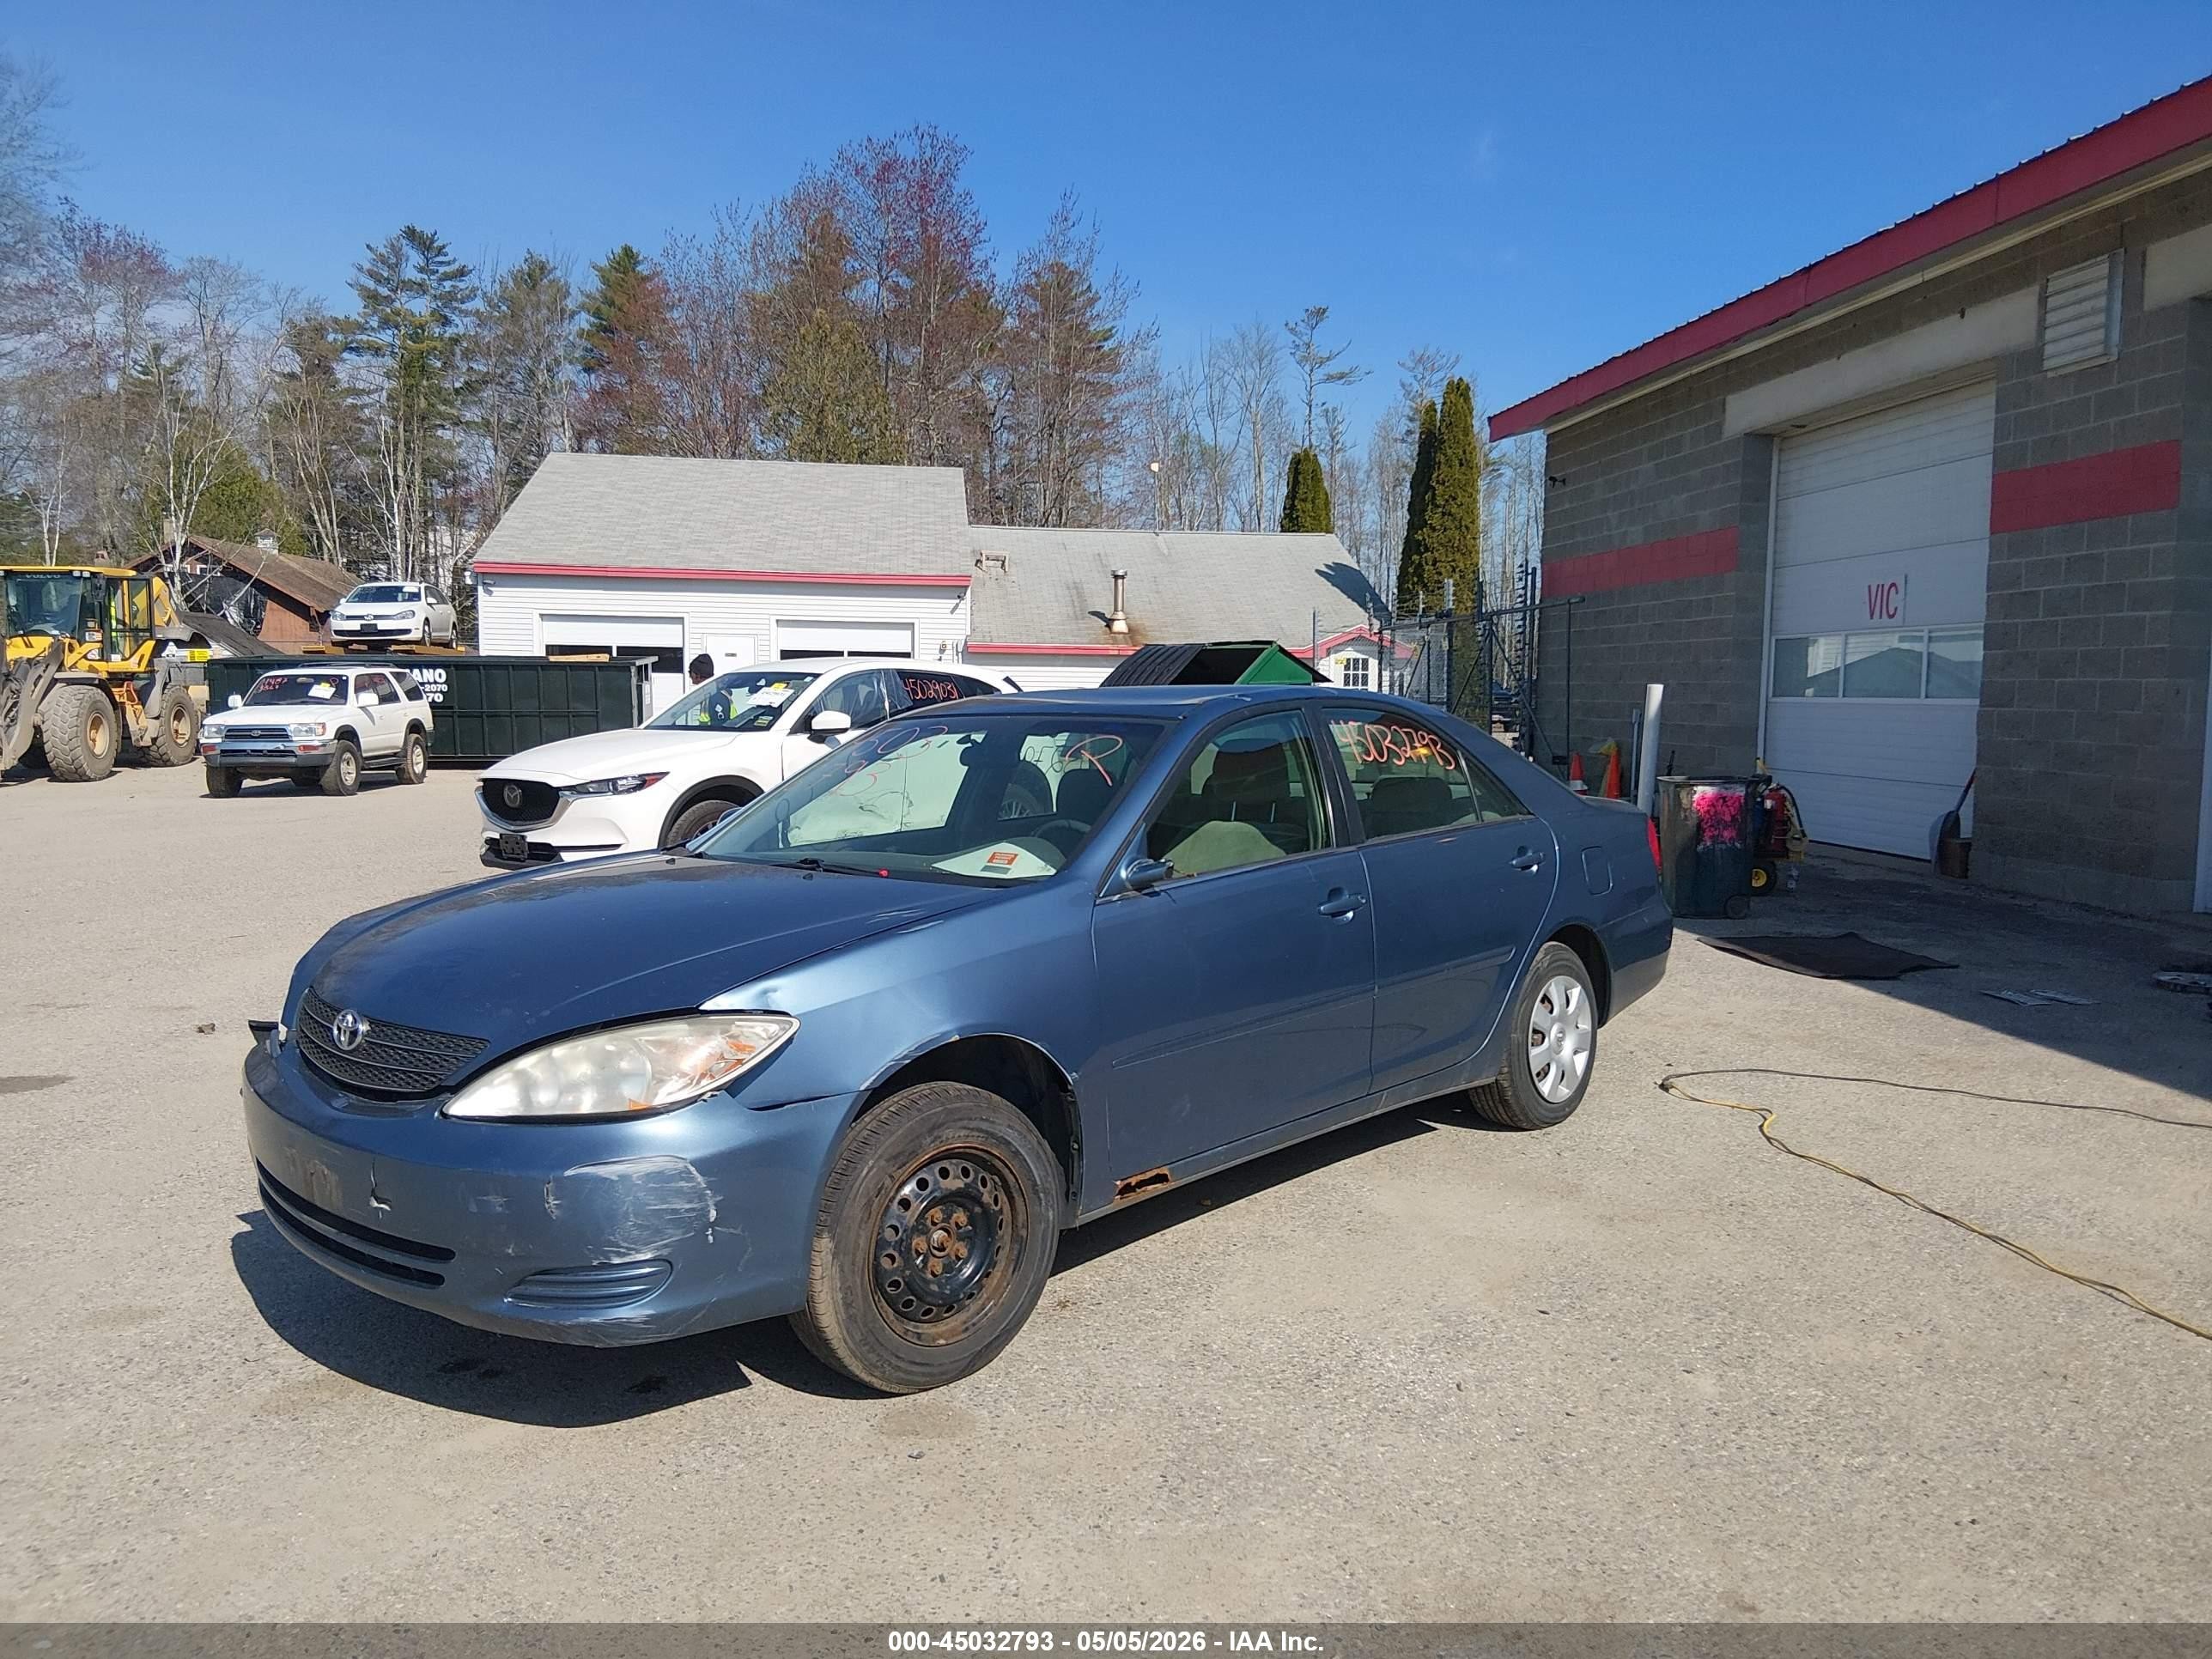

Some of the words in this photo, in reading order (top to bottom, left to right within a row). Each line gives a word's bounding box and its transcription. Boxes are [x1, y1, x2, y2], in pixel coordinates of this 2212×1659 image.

[1868, 582, 1899, 619] VIC
[411, 668, 447, 684] ANO
[421, 684, 448, 692] -2070
[426, 692, 444, 702] 70
[902, 678, 959, 701] 45029031
[1331, 720, 1455, 770] 45032793
